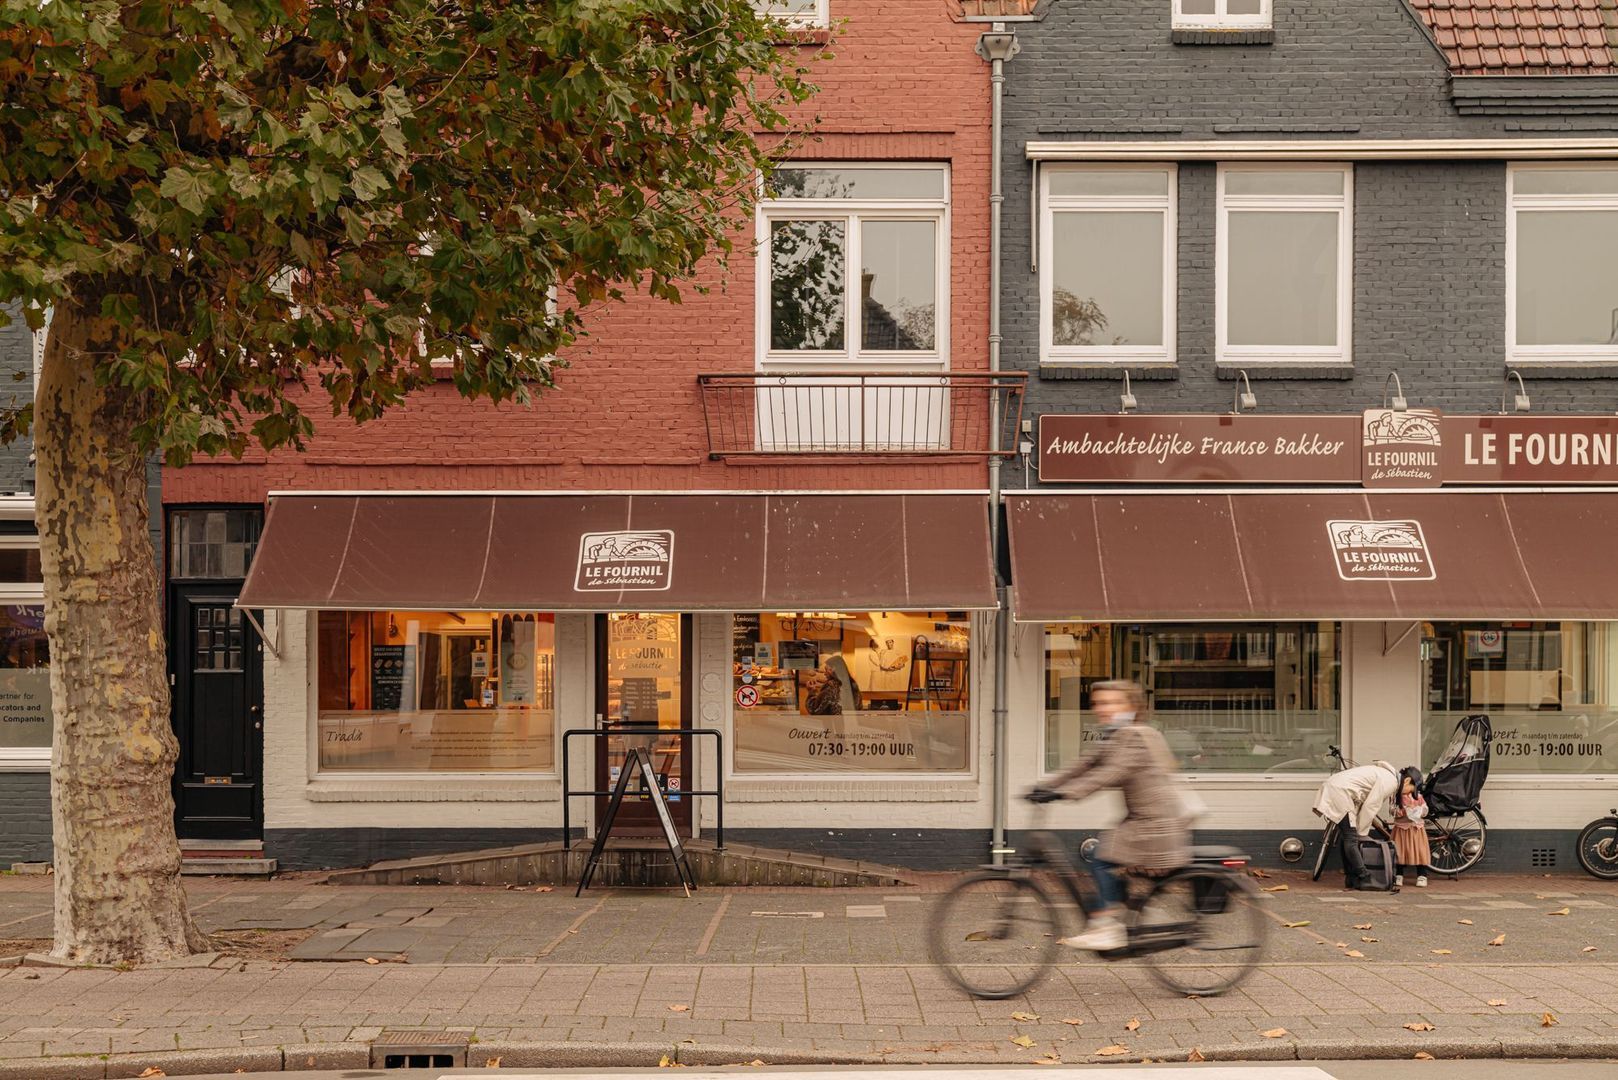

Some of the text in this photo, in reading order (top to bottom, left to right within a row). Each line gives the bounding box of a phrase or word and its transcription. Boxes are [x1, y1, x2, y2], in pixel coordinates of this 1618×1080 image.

[1046, 432, 1345, 464] Ambachtelijke Franse Bakker
[1464, 432, 1497, 466] LE
[1368, 451, 1438, 466] LE FOURNIL
[1371, 468, 1386, 480] de
[1343, 551, 1424, 564] LE FOURNIL
[585, 565, 664, 578] LE FOURNIL
[1351, 563, 1367, 573] de
[587, 578, 604, 586] de
[616, 647, 627, 659] LE
[24, 692, 34, 700] for
[3, 715, 45, 723] Companies
[788, 728, 832, 740] Ouvert
[1493, 728, 1519, 740] vert
[889, 742, 914, 756] UUR
[1578, 743, 1602, 756] UUR
